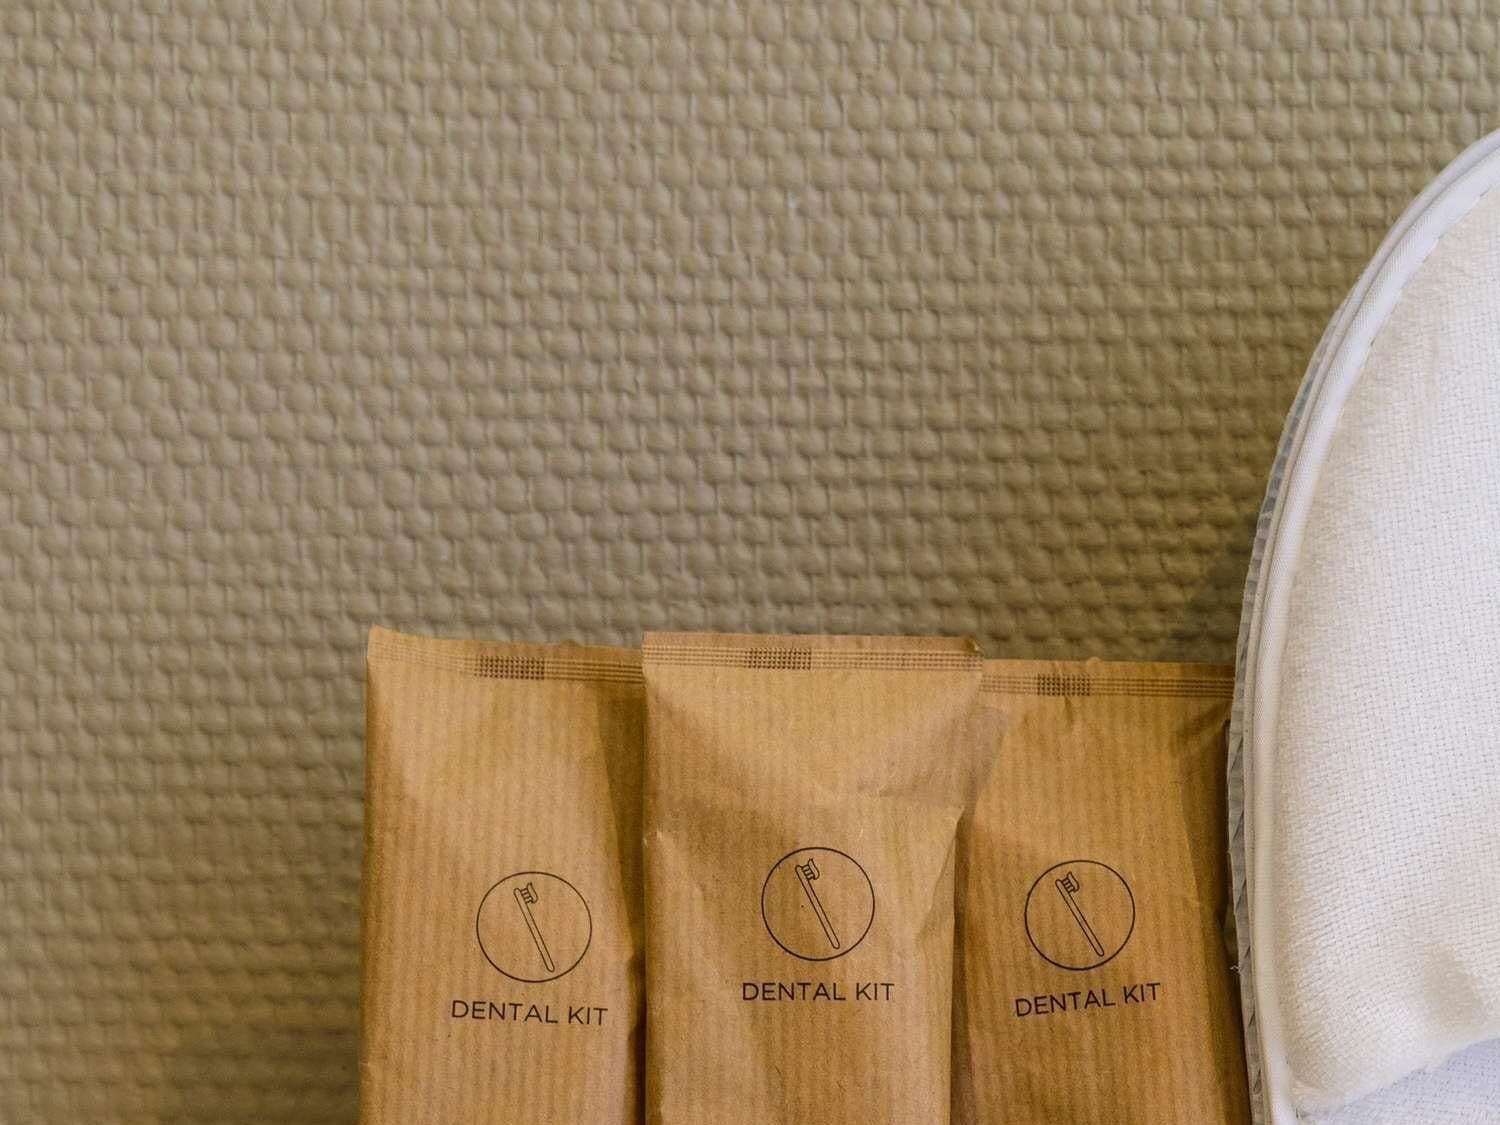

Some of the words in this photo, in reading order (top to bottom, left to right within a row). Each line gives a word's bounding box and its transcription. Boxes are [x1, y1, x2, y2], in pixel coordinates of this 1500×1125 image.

[742, 982, 846, 1001] DENTAL
[855, 982, 895, 1001] KIT
[1016, 989, 1115, 1017] DENTAL
[1123, 983, 1160, 1004] KIT
[452, 1000, 558, 1023] DENTAL
[567, 1005, 609, 1026] KIT
